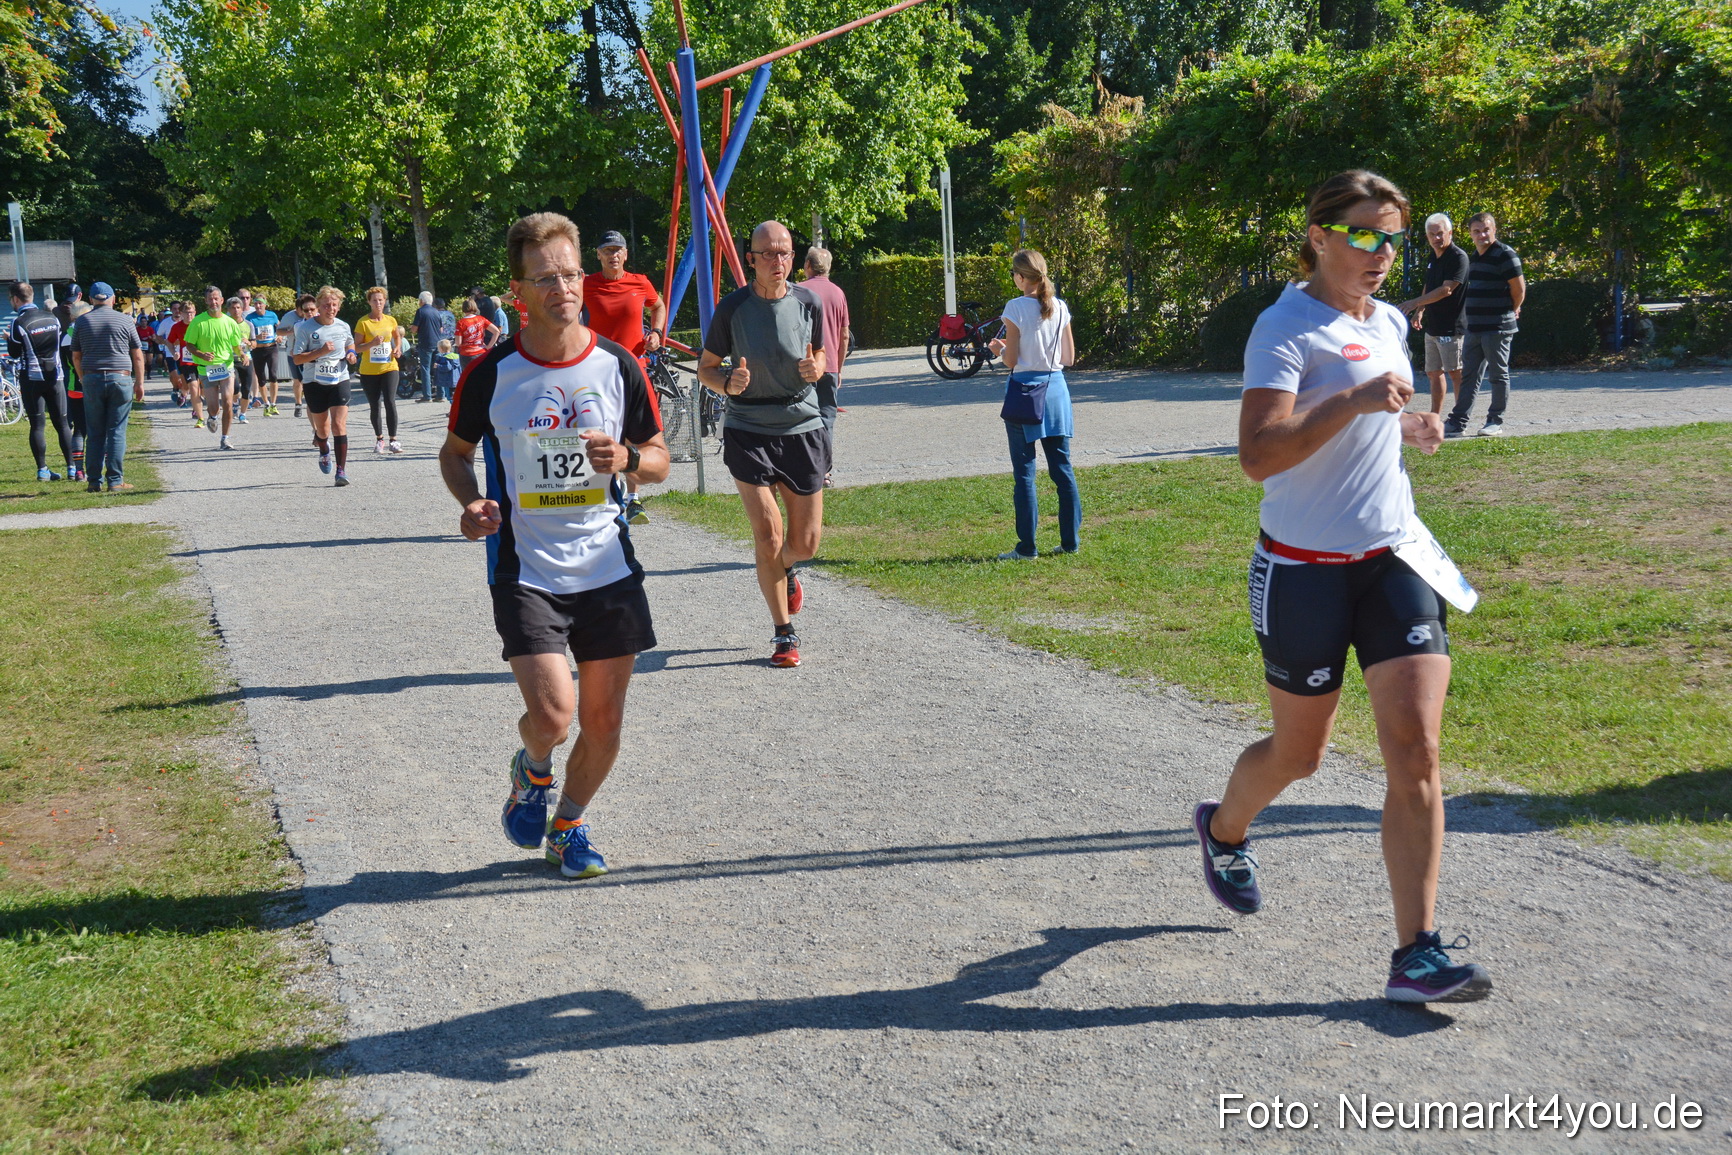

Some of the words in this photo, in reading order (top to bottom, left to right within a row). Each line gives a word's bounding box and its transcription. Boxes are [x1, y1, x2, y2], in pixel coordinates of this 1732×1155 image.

[528, 416, 551, 428] tkn
[537, 452, 585, 479] 132
[539, 494, 586, 506] Matthias
[1251, 572, 1265, 632] CARRERA
